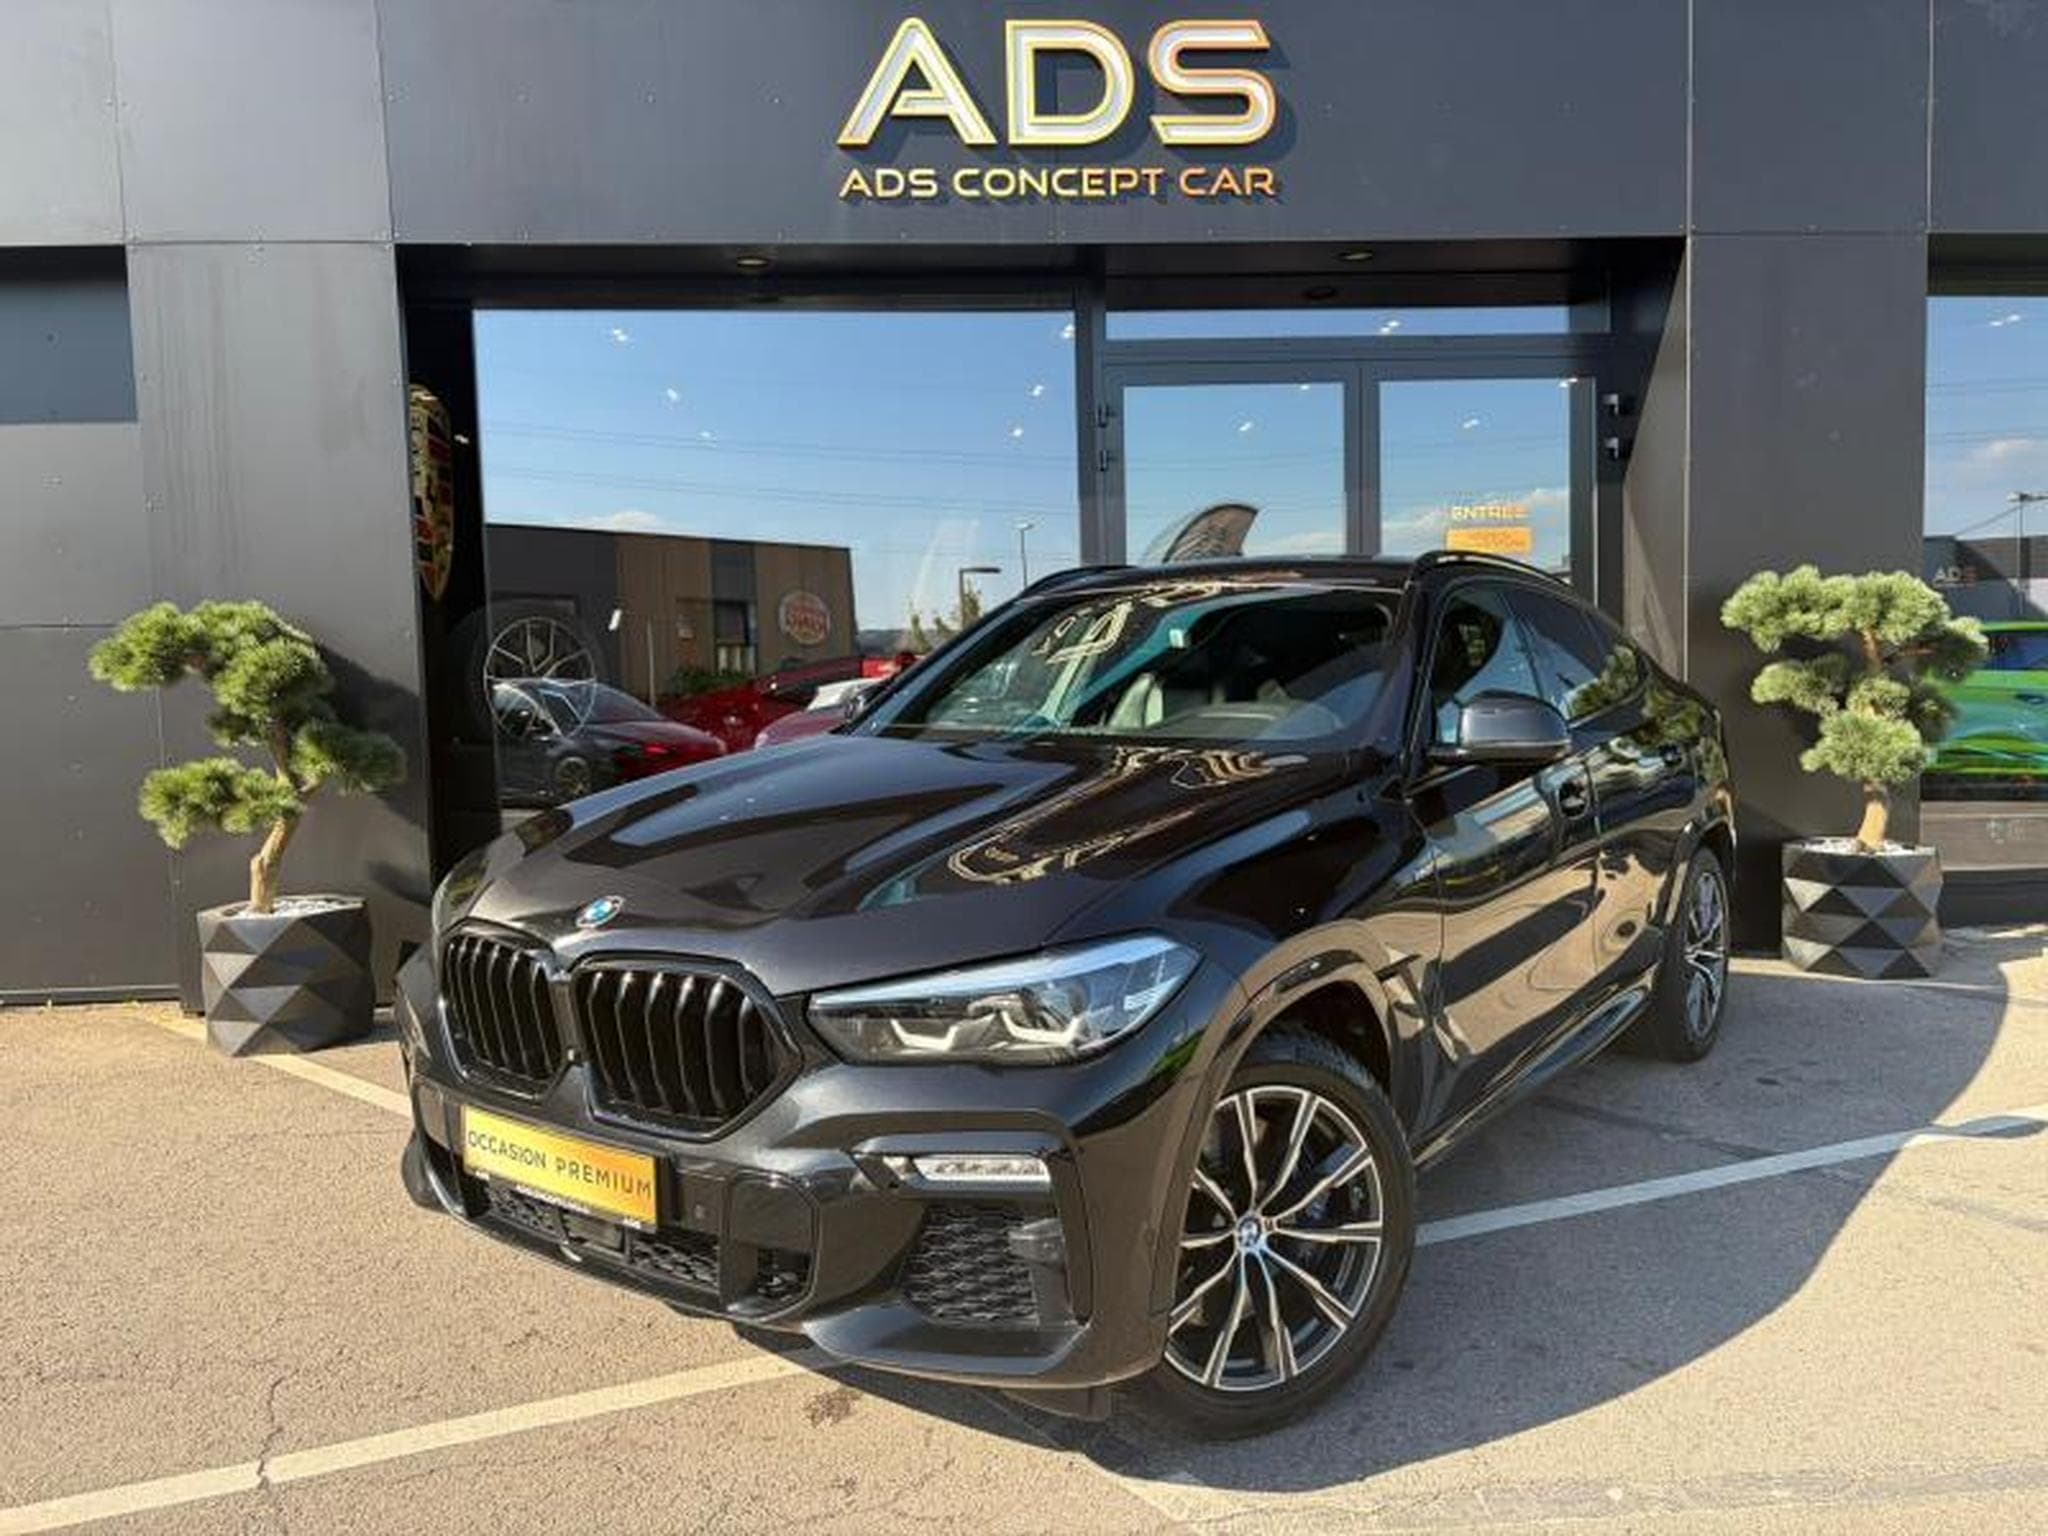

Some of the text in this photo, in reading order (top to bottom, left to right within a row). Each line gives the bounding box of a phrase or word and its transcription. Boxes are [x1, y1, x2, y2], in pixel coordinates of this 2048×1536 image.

[836, 17, 1277, 145] ADS
[839, 168, 1276, 198] ADS CONCEPT CAR
[467, 1130, 651, 1198] OCCASION PREMIUM
